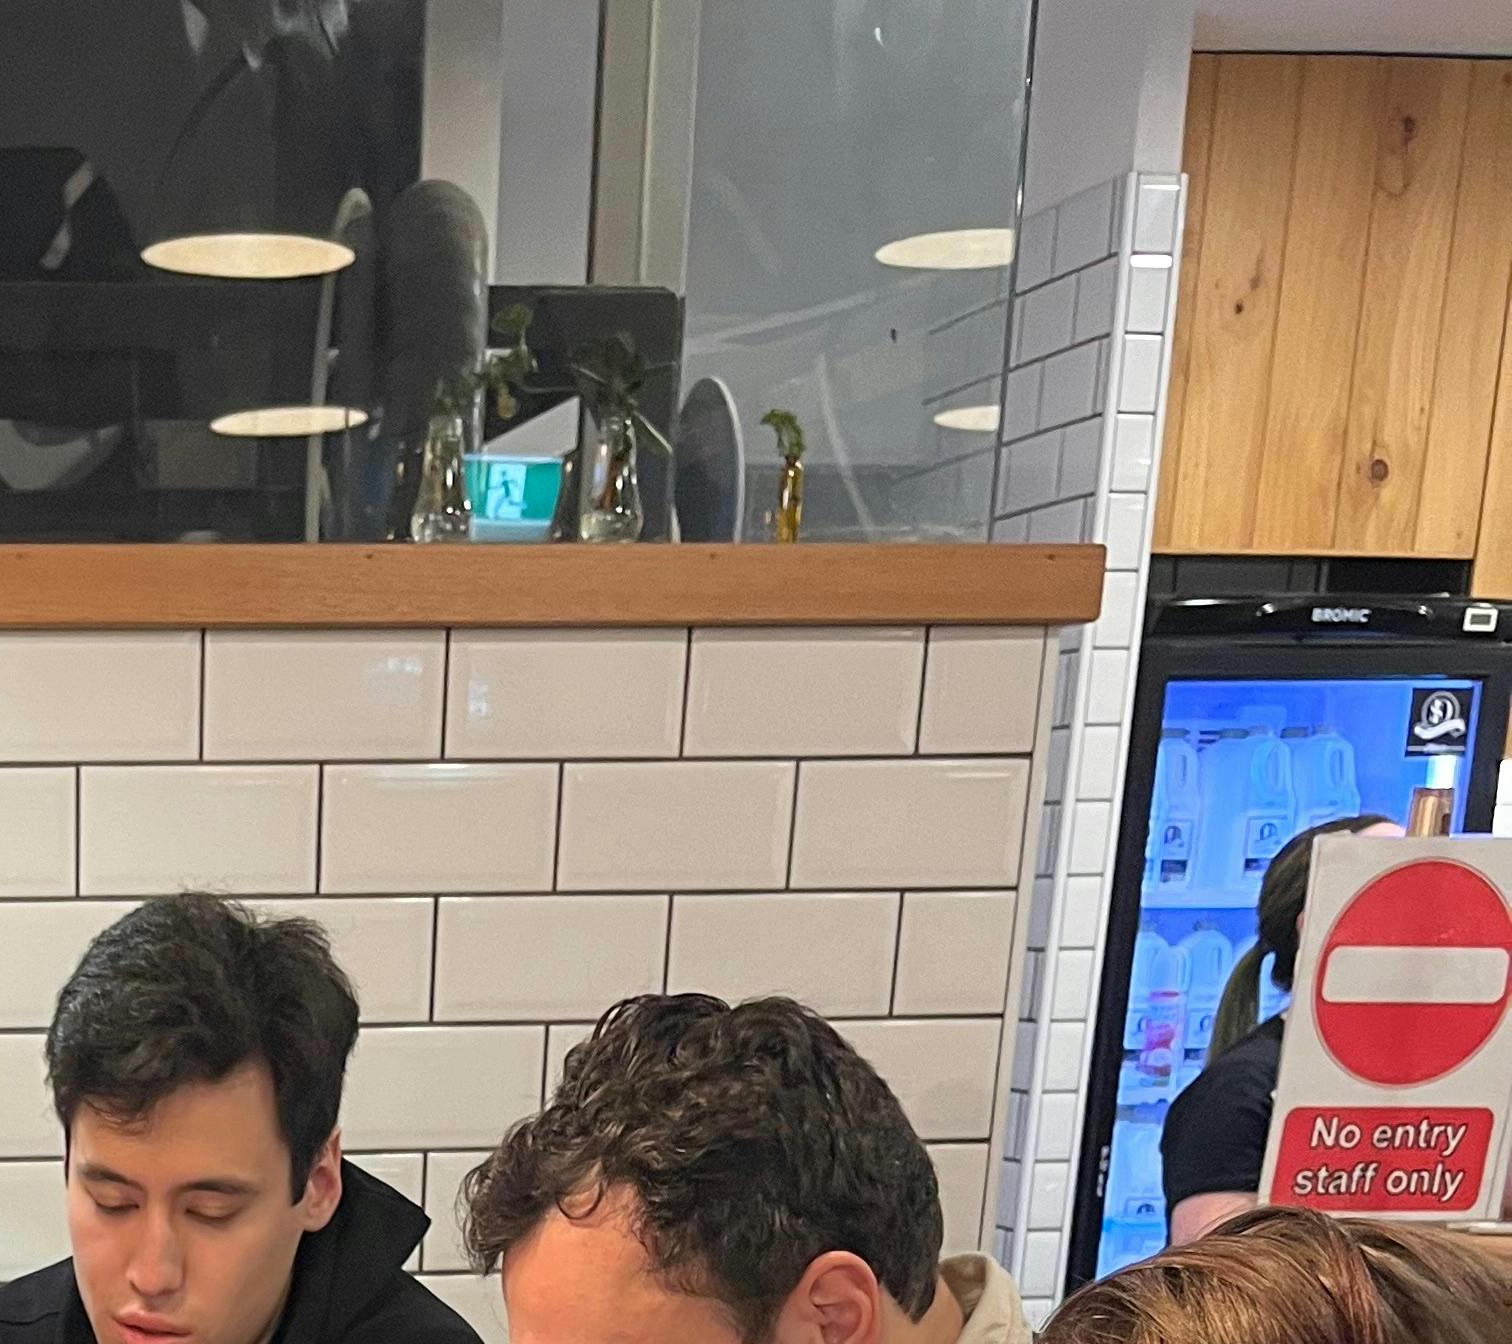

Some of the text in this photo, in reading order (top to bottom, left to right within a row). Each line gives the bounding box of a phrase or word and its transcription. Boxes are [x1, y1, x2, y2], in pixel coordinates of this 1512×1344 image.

[1311, 607, 1370, 624] BROMIC
[1309, 1119, 1467, 1156] No entry
[1293, 1163, 1463, 1201] staff only
